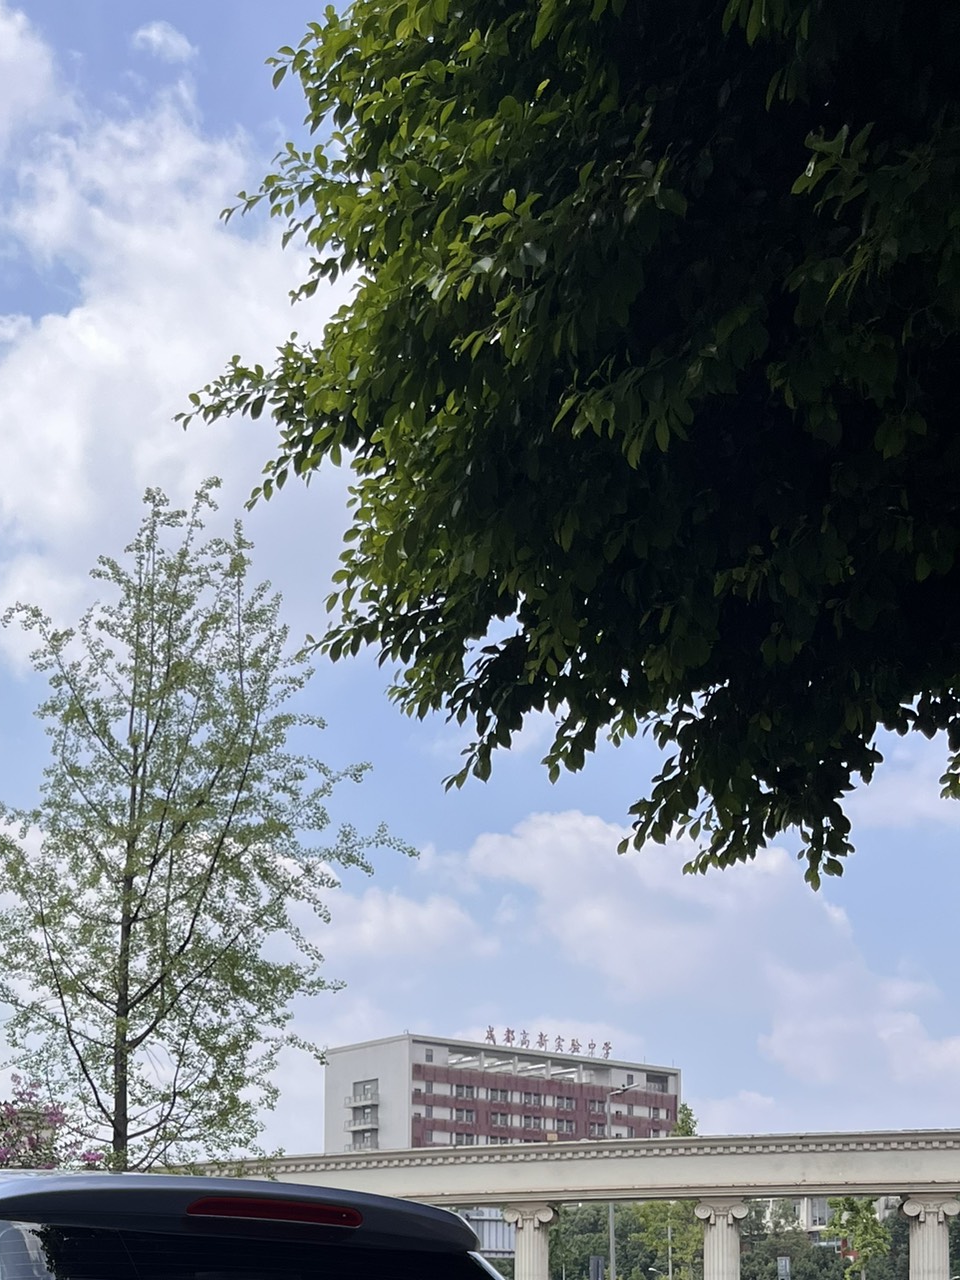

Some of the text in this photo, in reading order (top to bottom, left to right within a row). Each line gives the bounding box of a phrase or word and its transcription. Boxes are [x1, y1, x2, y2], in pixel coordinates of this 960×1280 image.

[485, 1025, 612, 1060] 成都高新实验中学
